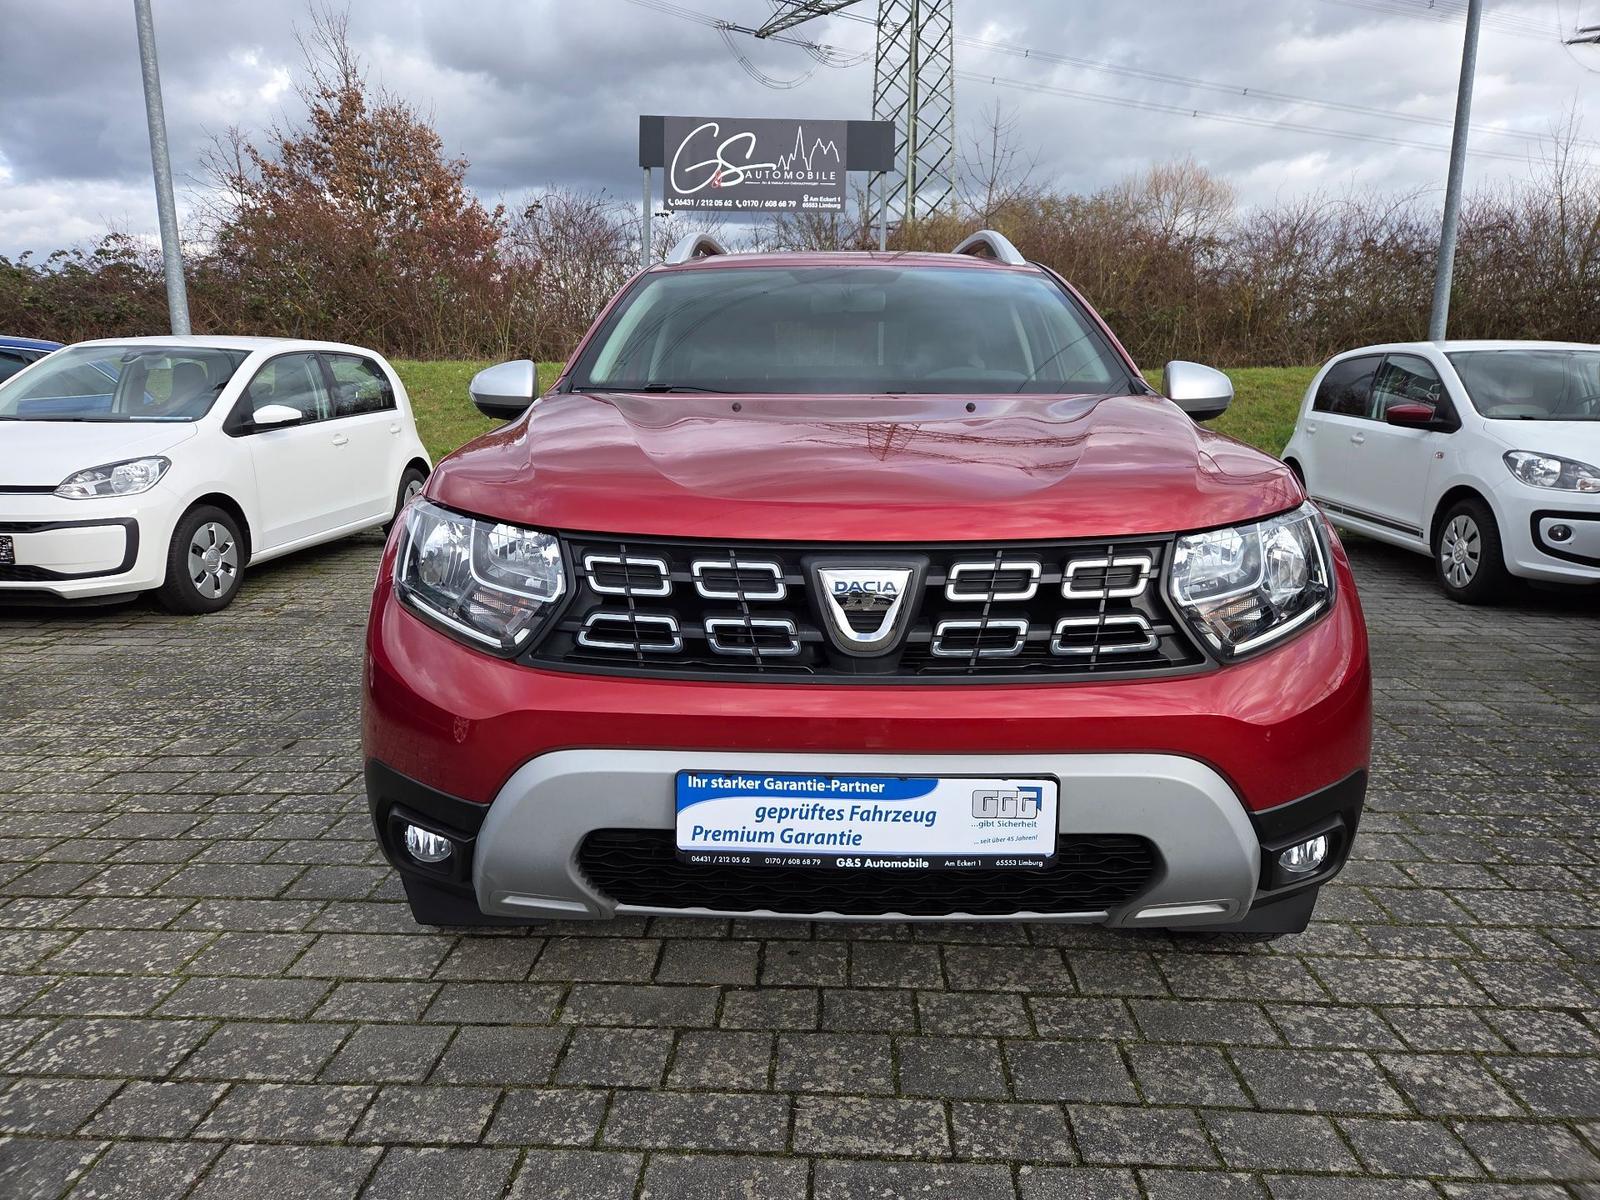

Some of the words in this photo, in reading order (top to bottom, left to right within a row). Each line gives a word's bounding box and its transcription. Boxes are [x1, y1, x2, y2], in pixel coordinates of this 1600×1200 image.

[745, 170, 836, 180] AUTOMOBILE
[674, 198, 695, 206] 06431
[700, 199, 713, 207] 212
[714, 199, 723, 207] 05
[764, 200, 778, 208] 608
[787, 200, 797, 208] 79
[834, 581, 897, 593] DACIA
[687, 776, 708, 788] Ihr
[711, 776, 761, 789] starker
[763, 778, 885, 793] Garantie-Partner
[755, 803, 844, 823] geprüftes
[849, 805, 937, 828] Fahrzeug
[997, 820, 1037, 828] Sicherheit
[691, 825, 775, 843] Premium
[779, 828, 863, 846] Garantie
[691, 855, 711, 863] 06431
[765, 857, 781, 865] 0170
[812, 858, 821, 866] 79
[836, 858, 862, 868] G&S
[864, 858, 930, 868] Automobile
[1018, 860, 1044, 868] Limburg
